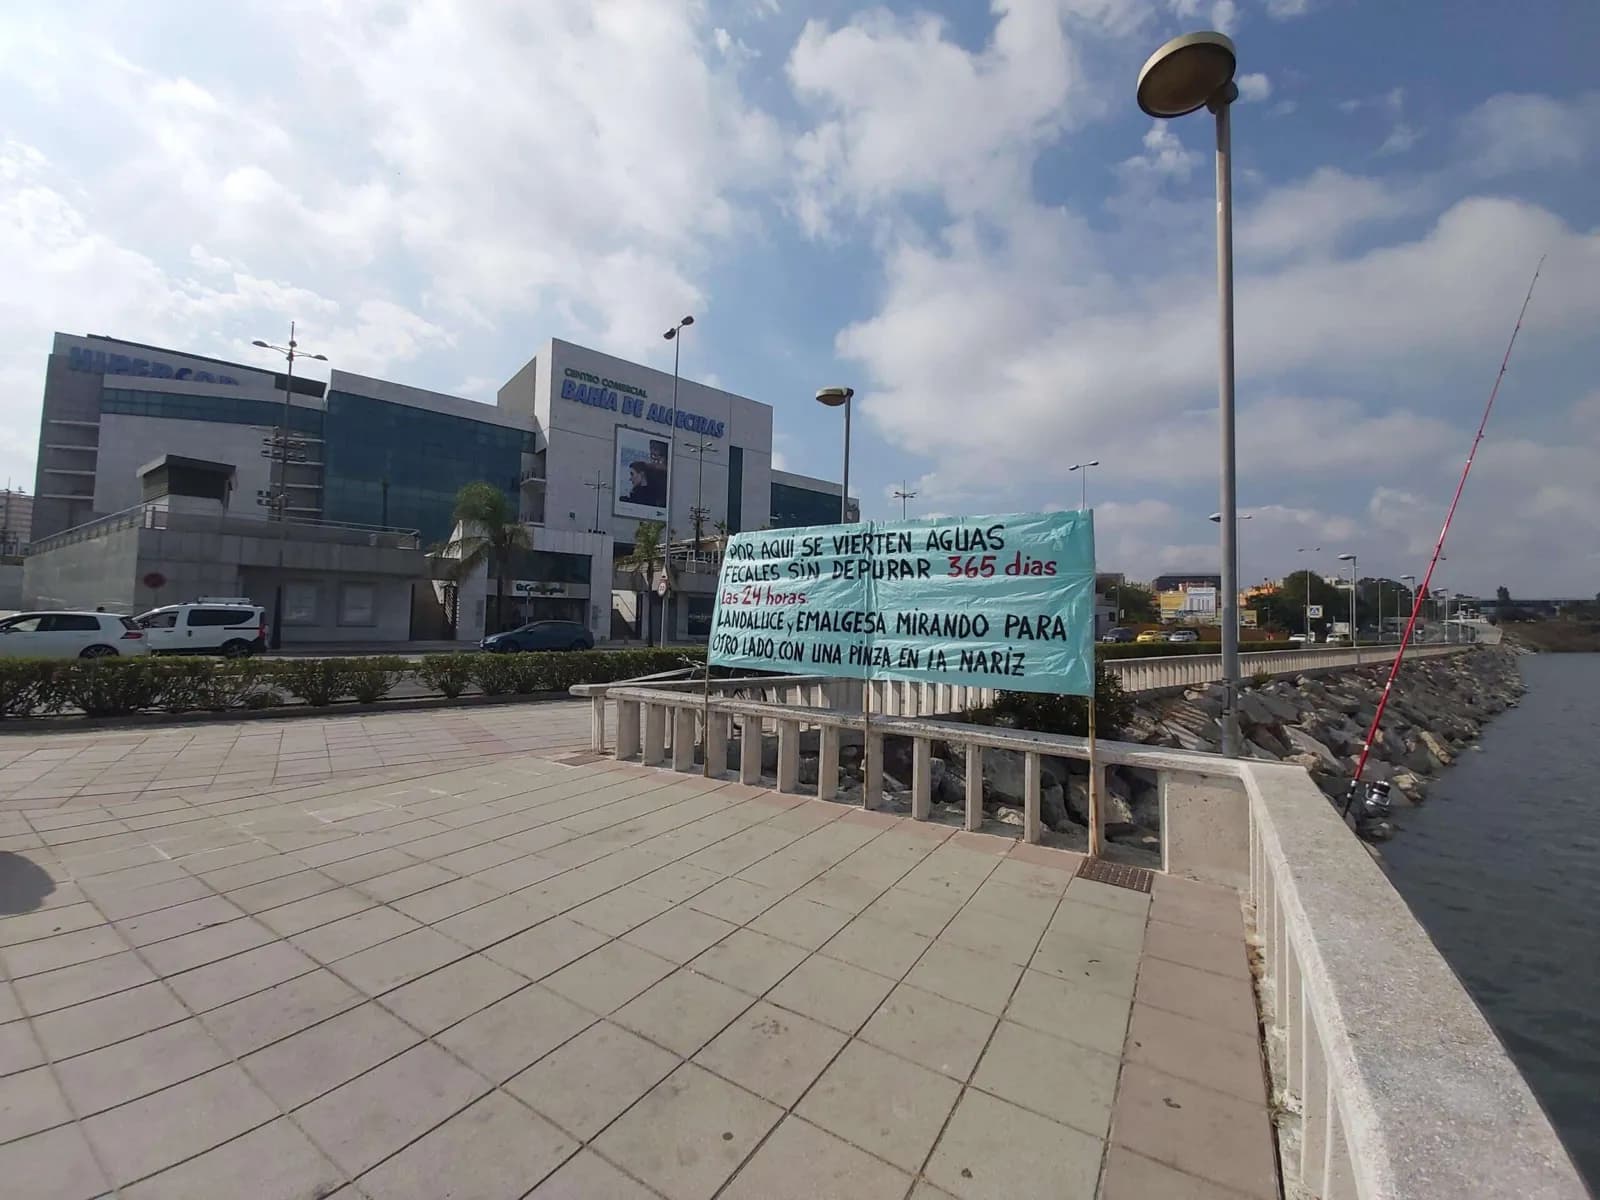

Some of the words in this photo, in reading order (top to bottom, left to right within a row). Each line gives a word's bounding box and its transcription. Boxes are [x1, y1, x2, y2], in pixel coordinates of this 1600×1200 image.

[564, 368, 600, 385] CENTRO
[602, 378, 648, 398] COMERCIAL
[561, 379, 618, 412] BAHÍA
[621, 395, 645, 418] DE
[646, 403, 726, 438] ALGECIRAS
[729, 542, 755, 560] POR
[801, 536, 824, 557] SE
[926, 524, 1005, 552] AGUAS
[723, 563, 780, 584] FECALES
[832, 557, 931, 580] DEPURAR
[947, 555, 997, 578] 365
[742, 585, 762, 606] 24
[717, 609, 785, 631] LANDALUCE
[796, 610, 886, 634] EMALGESA
[1004, 614, 1067, 641] PARA
[712, 633, 739, 655] OTRO
[778, 640, 805, 662] CON
[812, 643, 842, 665] UNA
[899, 648, 919, 669] EN
[927, 650, 947, 673] LA
[959, 646, 1026, 677] NARIZ
